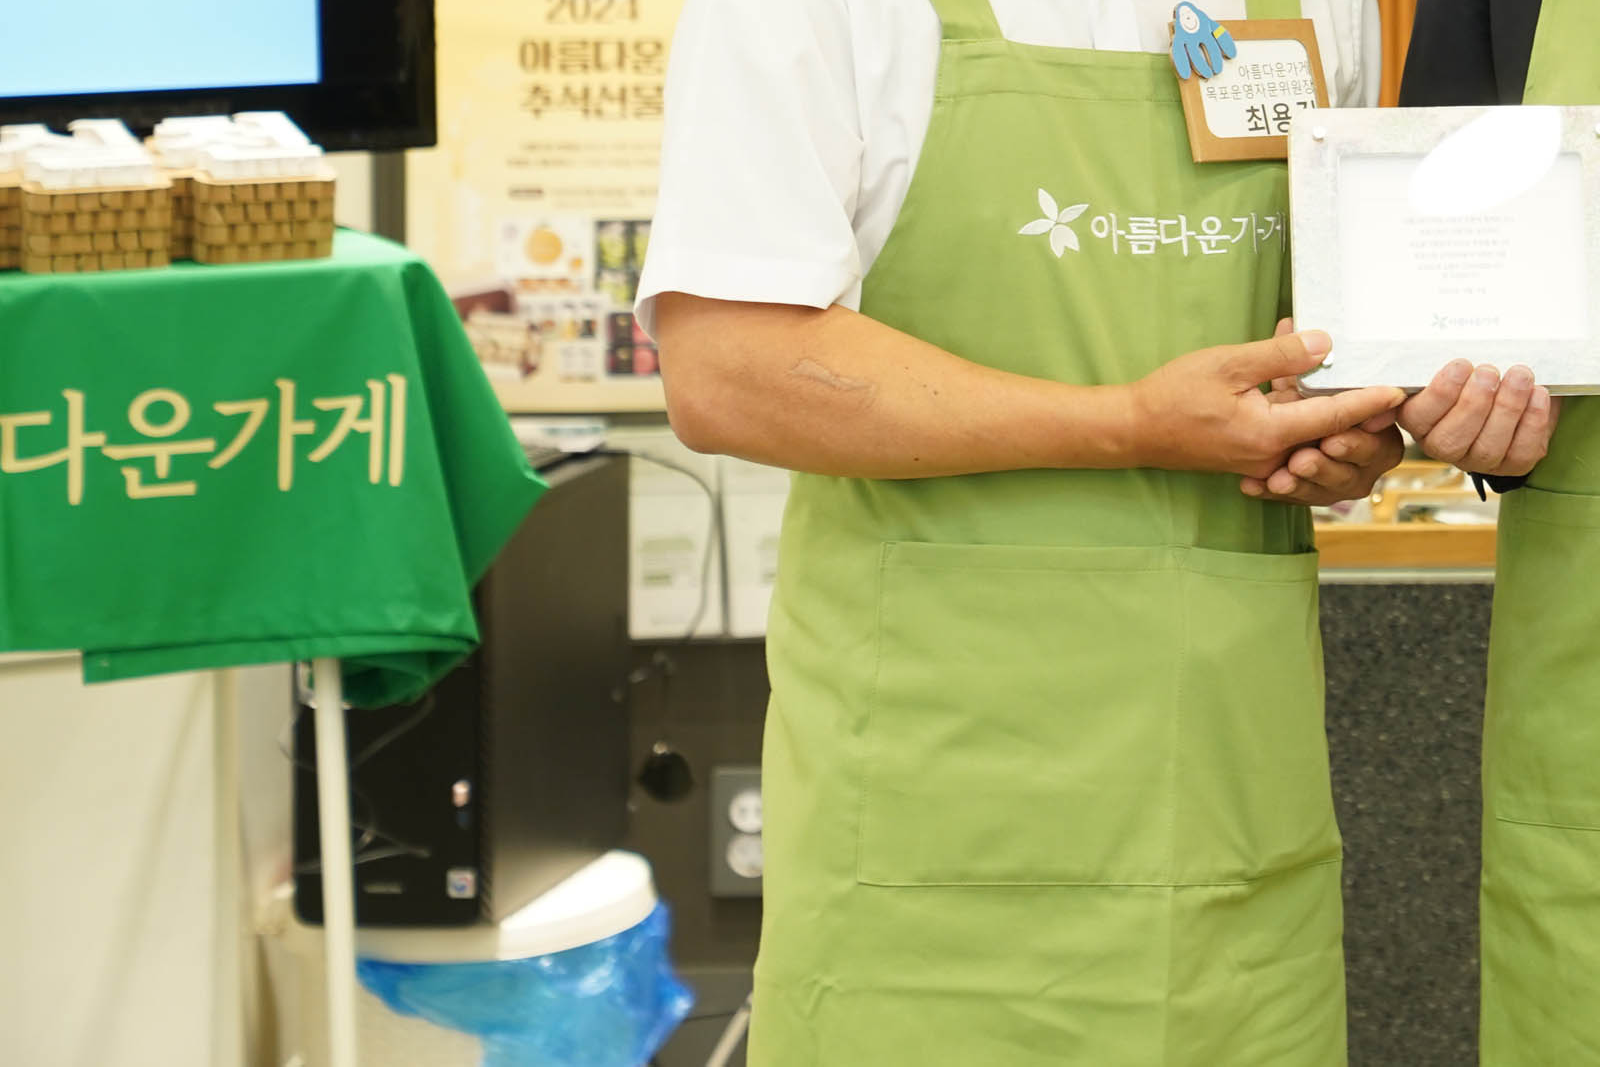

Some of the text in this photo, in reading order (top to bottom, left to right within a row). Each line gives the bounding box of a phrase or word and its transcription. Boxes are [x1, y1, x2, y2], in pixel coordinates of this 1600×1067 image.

[519, 38, 664, 74] 아름다운
[1246, 100, 1315, 134] 최용
[1090, 212, 1287, 256] 아름다운가게
[0, 373, 407, 505] 다운가게
